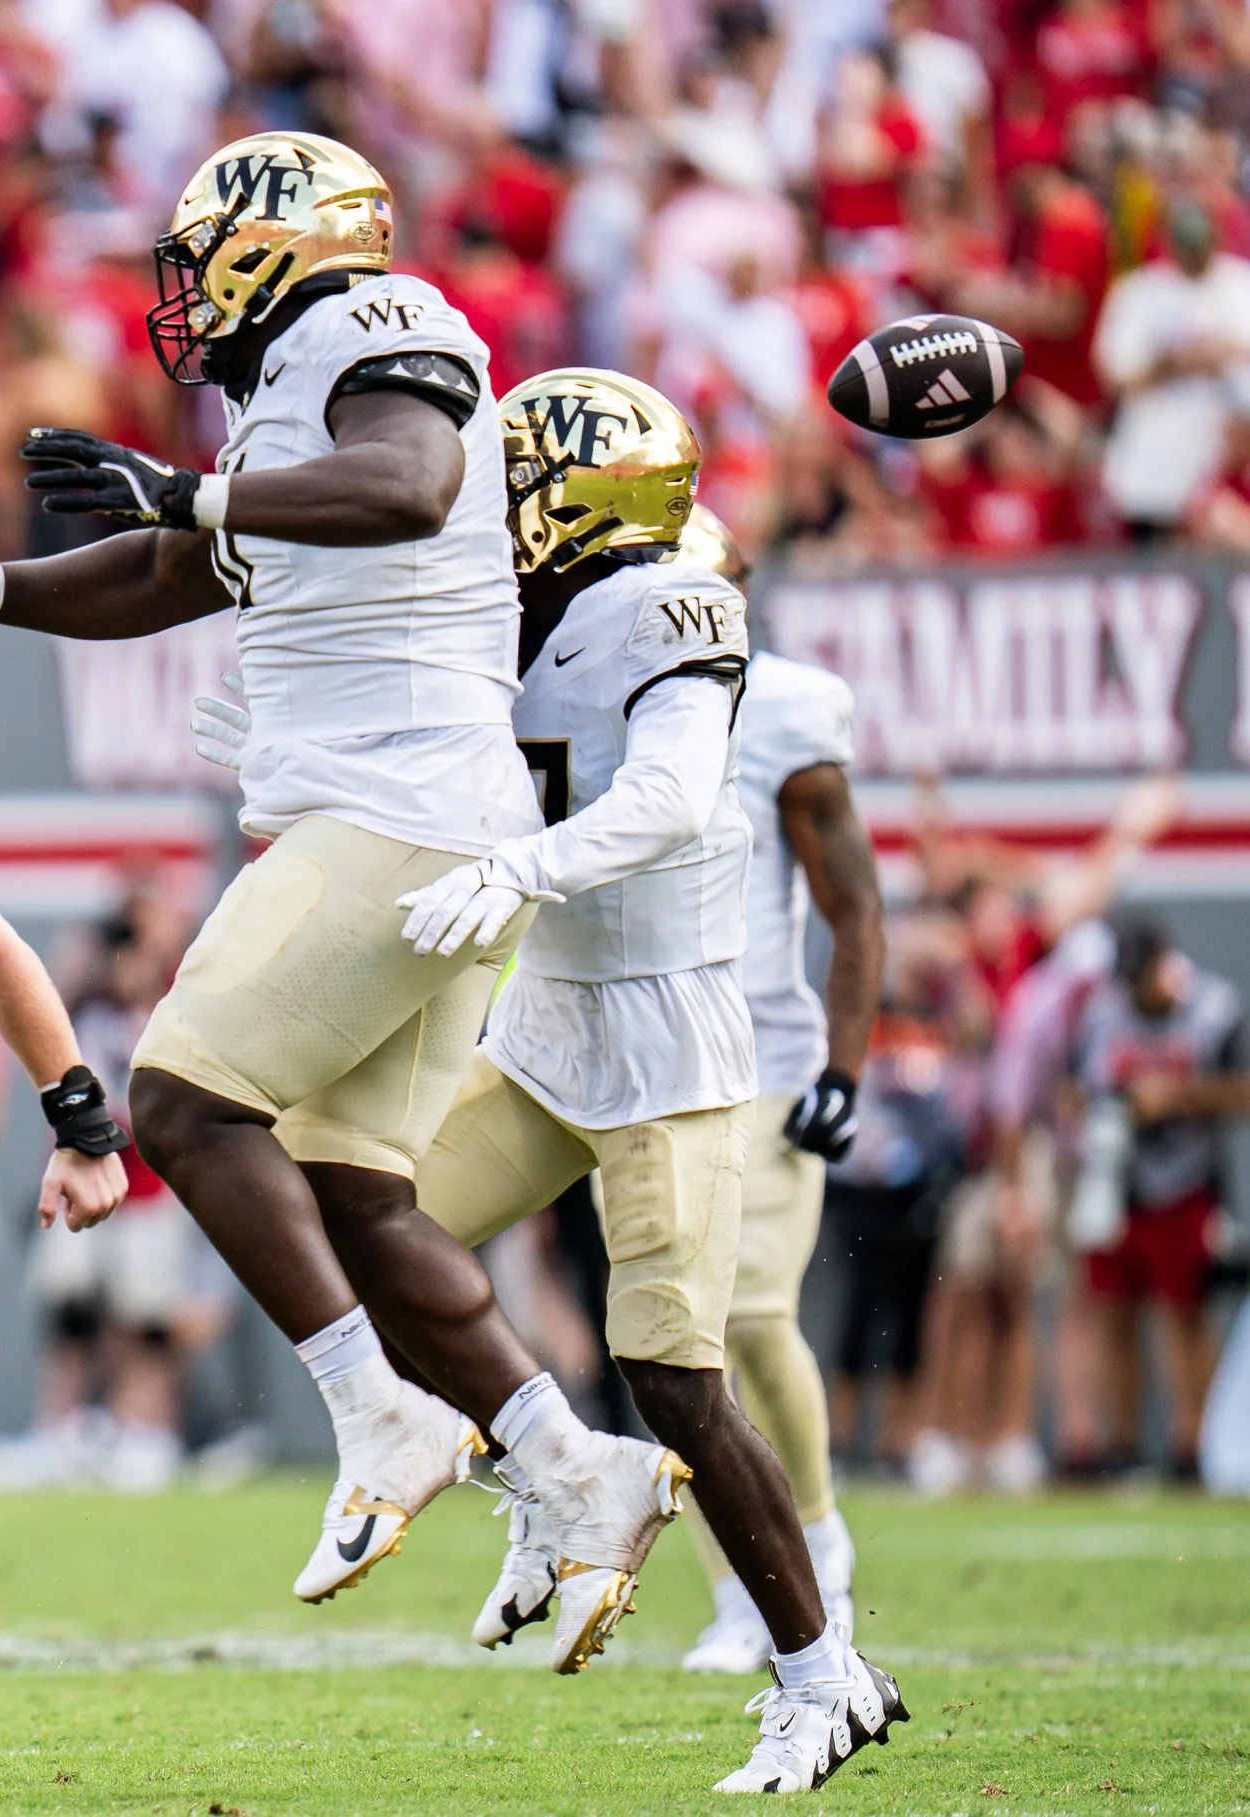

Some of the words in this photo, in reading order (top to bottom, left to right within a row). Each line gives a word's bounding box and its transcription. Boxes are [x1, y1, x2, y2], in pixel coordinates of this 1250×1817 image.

[215, 155, 315, 221] WF
[347, 297, 425, 333] WF
[521, 395, 628, 470] WF
[657, 596, 727, 644] WF
